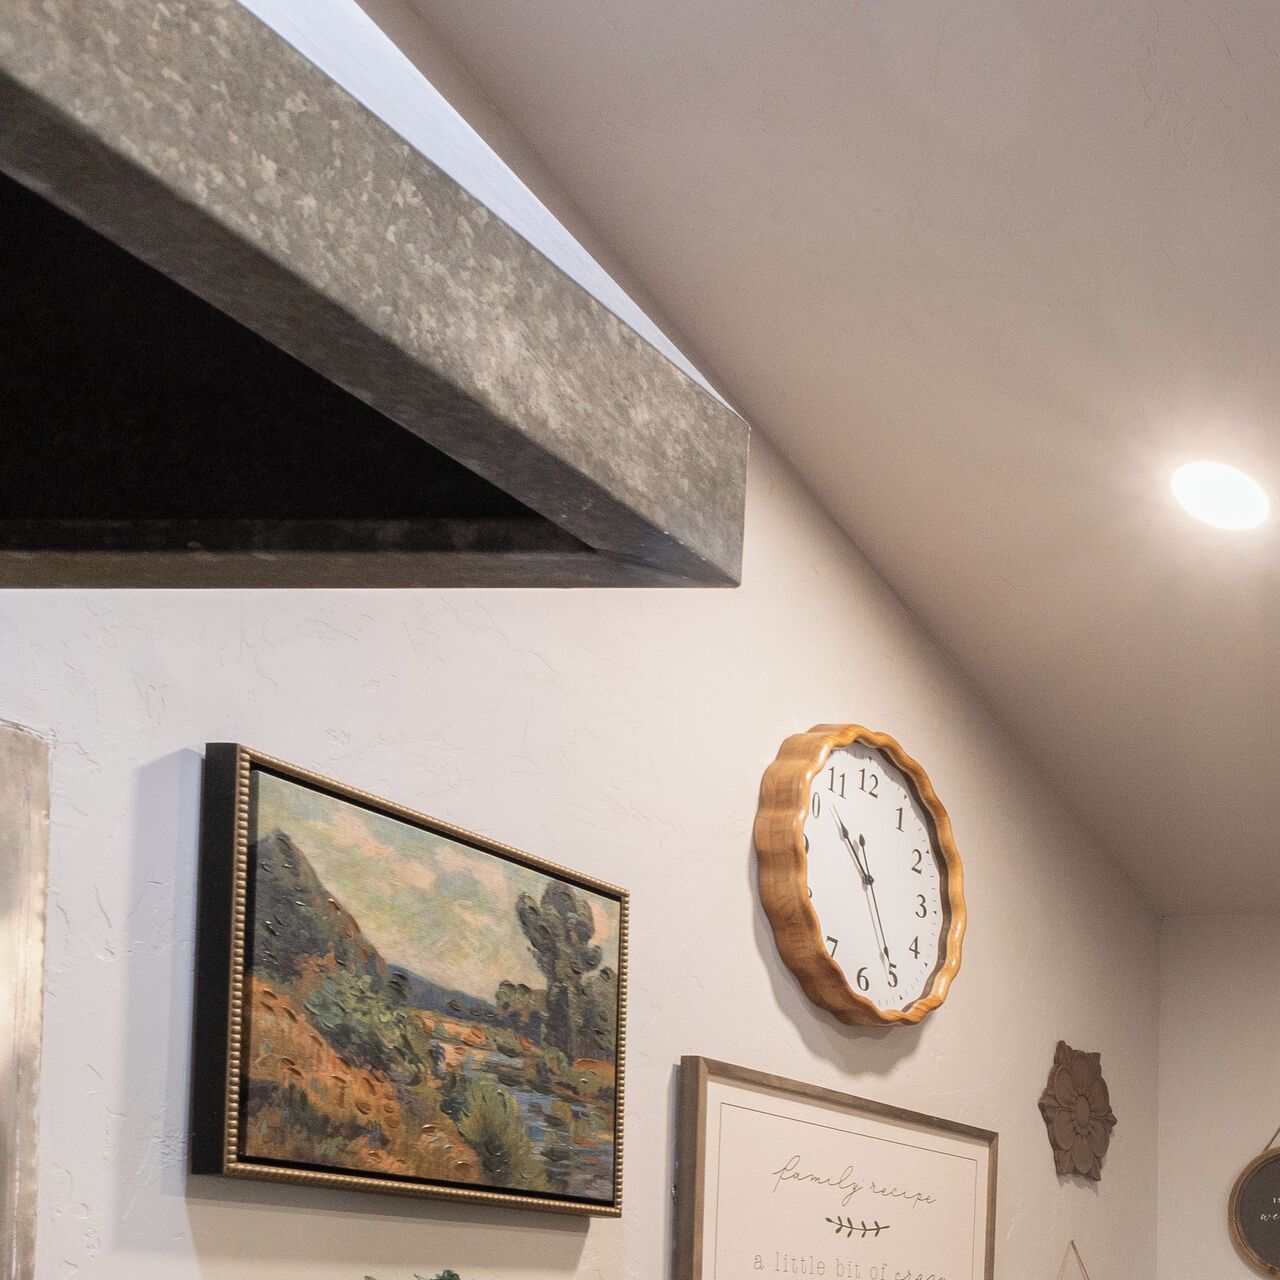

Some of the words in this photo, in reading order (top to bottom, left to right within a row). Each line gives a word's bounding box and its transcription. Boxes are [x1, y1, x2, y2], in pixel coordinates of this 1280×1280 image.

[827, 766, 847, 800] 11
[858, 767, 879, 799] 12
[895, 806, 905, 833] 1
[911, 848, 922, 875] 2
[915, 893, 927, 919] 3
[908, 935, 921, 960] 4
[856, 965, 870, 992] 6
[887, 962, 898, 988] 5
[772, 1154, 864, 1206] family
[864, 1180, 937, 1209] recipe
[753, 1254, 764, 1271] a
[774, 1251, 826, 1277] little
[836, 1256, 862, 1280] bit
[869, 1262, 888, 1280] of
